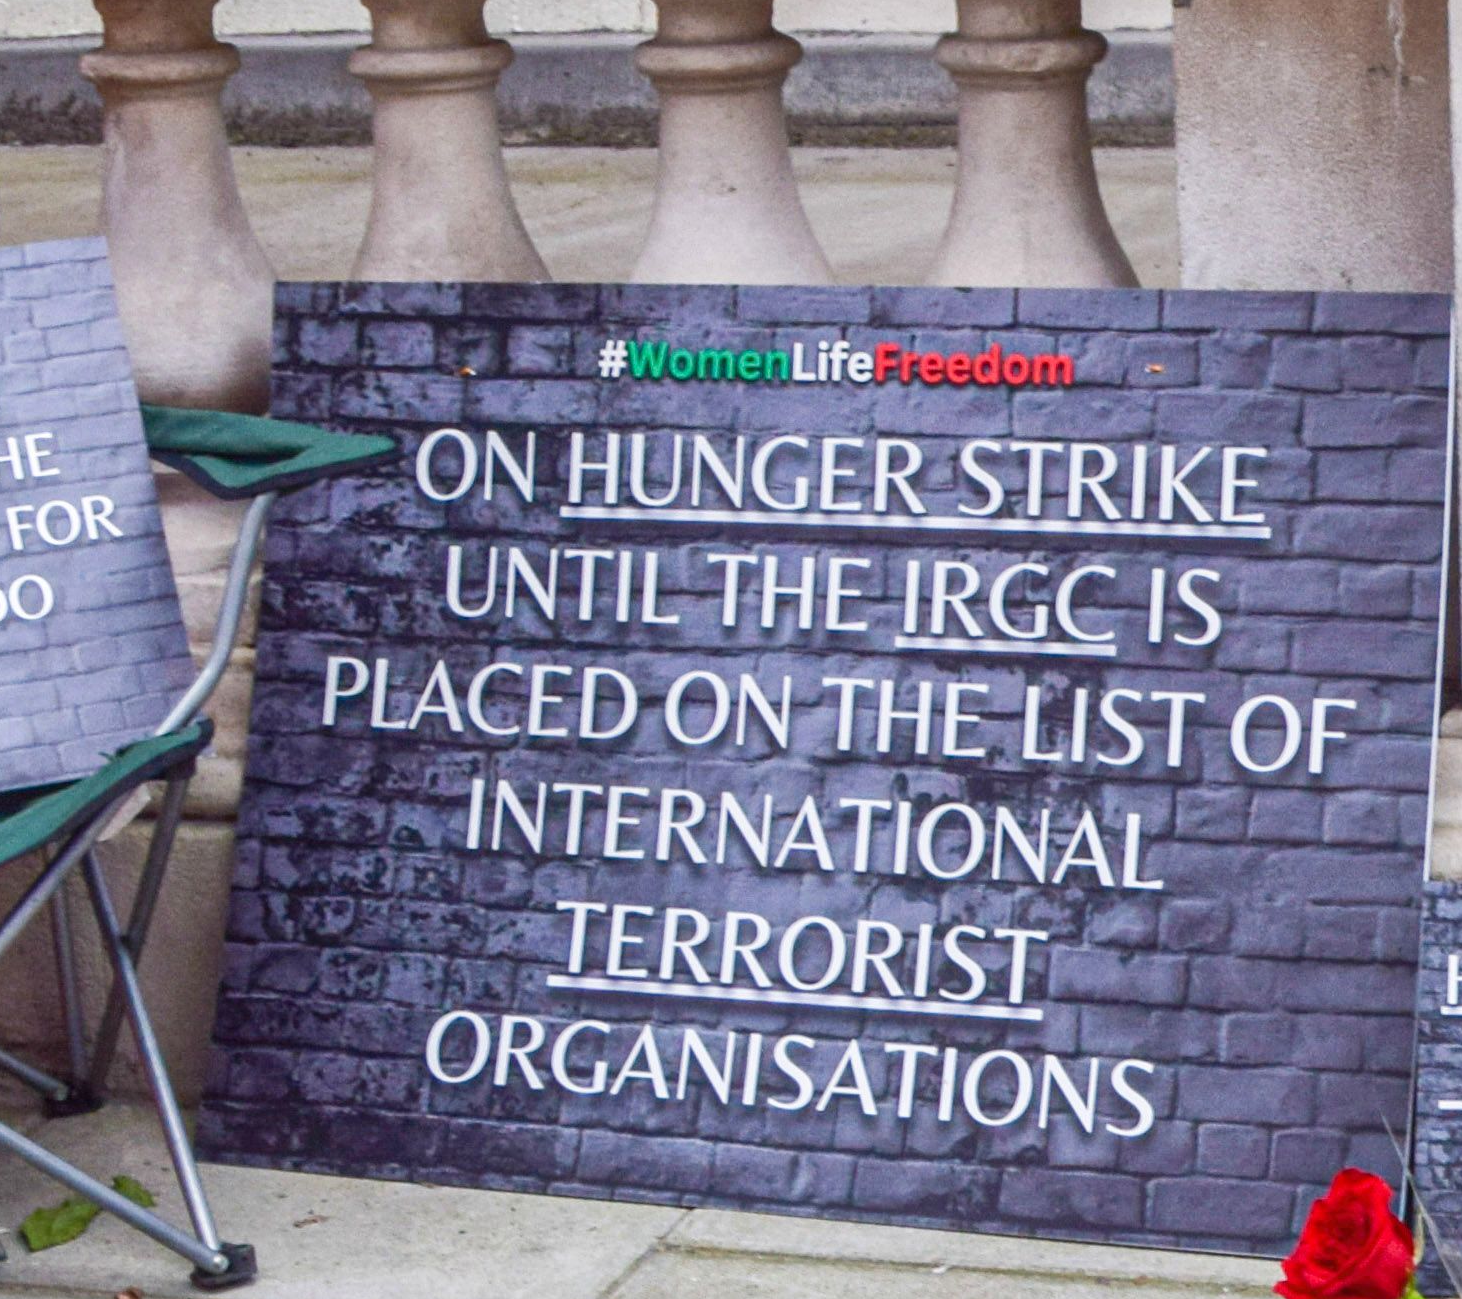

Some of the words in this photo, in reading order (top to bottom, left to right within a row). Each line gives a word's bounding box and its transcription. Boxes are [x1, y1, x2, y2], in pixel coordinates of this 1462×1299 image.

[598, 338, 1074, 386] #WomenLifeFreedom
[5, 493, 123, 550] FOR
[416, 429, 536, 501] ON
[568, 430, 926, 514] HUNGER
[958, 439, 1268, 525] STRIKE
[447, 545, 681, 625] UNTIL
[707, 552, 872, 632] THE
[903, 555, 1117, 642] IRGC
[1148, 567, 1222, 646] IS
[322, 656, 638, 740] PLACED
[664, 667, 792, 749] ON
[823, 676, 988, 758] THE
[1021, 685, 1206, 767] LIST
[1230, 694, 1358, 774] OF
[466, 778, 1164, 890] INTERNATIONAL
[555, 900, 1049, 1004] TERRORIST
[425, 1010, 1156, 1137] ORGANISATIONS
